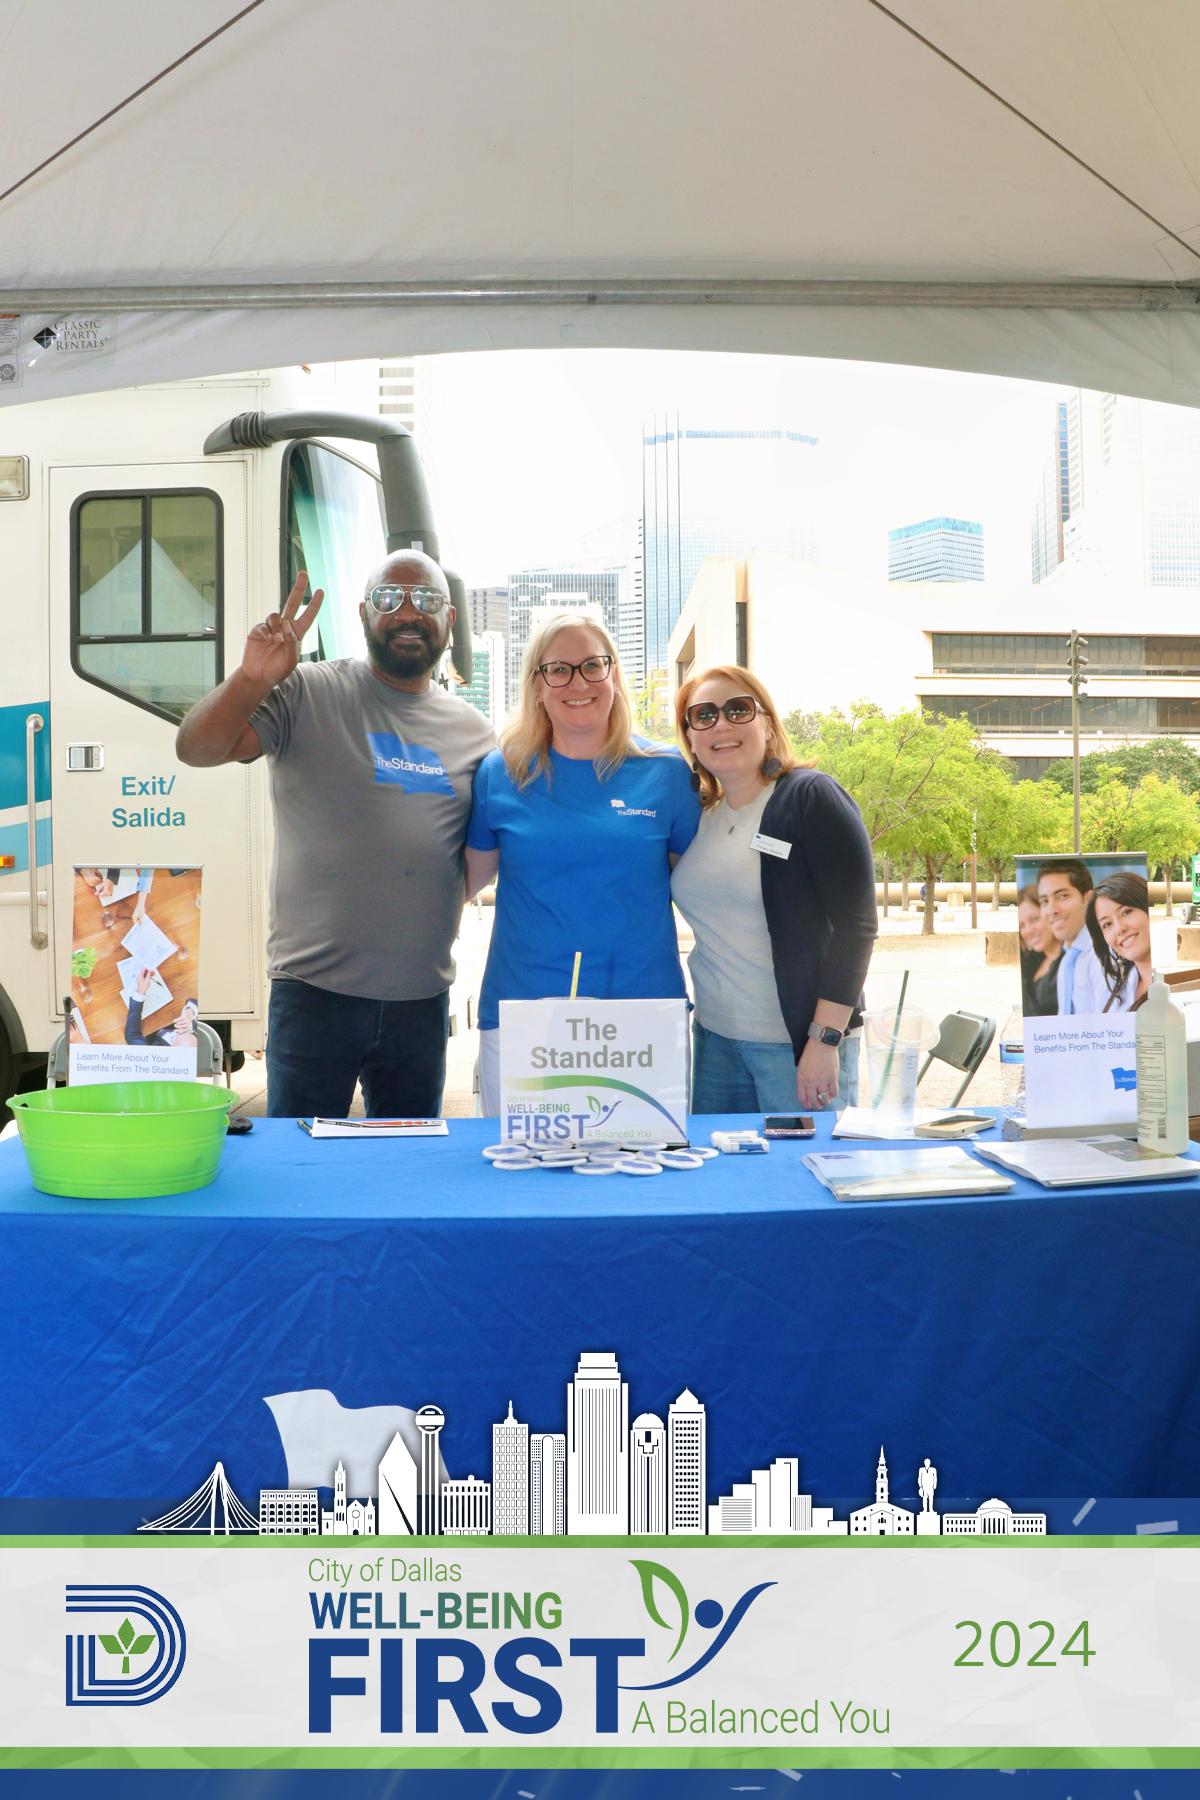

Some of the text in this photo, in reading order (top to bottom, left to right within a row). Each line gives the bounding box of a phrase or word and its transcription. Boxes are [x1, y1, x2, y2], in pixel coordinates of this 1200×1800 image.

[54, 320, 102, 331] CLASSIC
[64, 330, 98, 340] PARTY
[56, 340, 105, 351] RENTALS
[121, 774, 176, 796] Exit/
[111, 806, 186, 828] Salida
[565, 1017, 618, 1041] The
[1033, 1029, 1125, 1042] Learn More About Your
[1034, 1044, 1067, 1054] Benefits
[1068, 1043, 1090, 1052] From
[1091, 1042, 1106, 1050] The
[1107, 1041, 1136, 1050] Standa
[76, 1052, 171, 1063] Learn More About Your
[530, 1043, 654, 1069] Standard
[76, 1063, 190, 1076] Benefits From The Standard
[507, 1103, 571, 1114] WELL-BEING
[507, 1114, 591, 1140] FIRST
